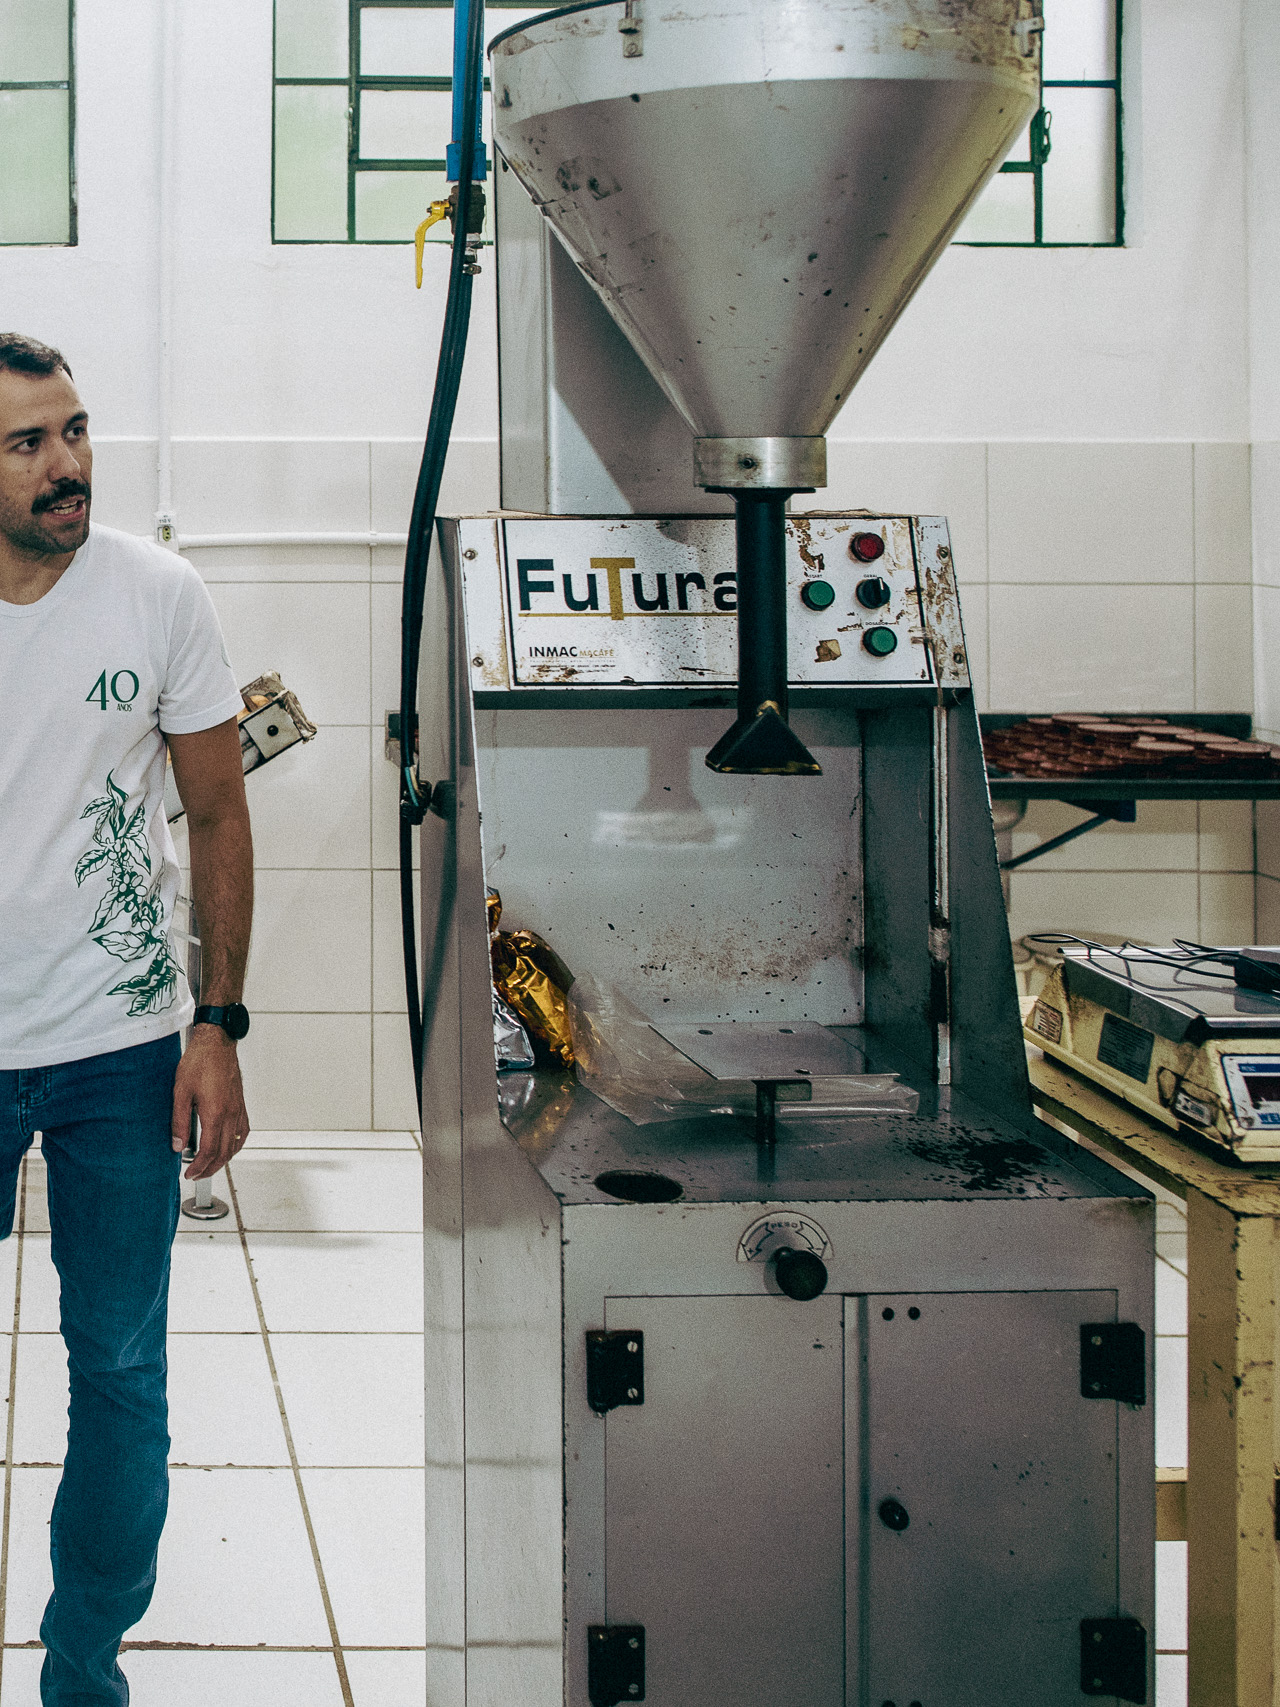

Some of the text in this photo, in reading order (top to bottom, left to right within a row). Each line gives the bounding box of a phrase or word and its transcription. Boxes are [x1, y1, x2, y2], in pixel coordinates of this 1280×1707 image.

[516, 557, 737, 620] FuTura
[529, 646, 578, 657] INMAC
[85, 668, 140, 710] 40
[116, 704, 132, 712] ANOS
